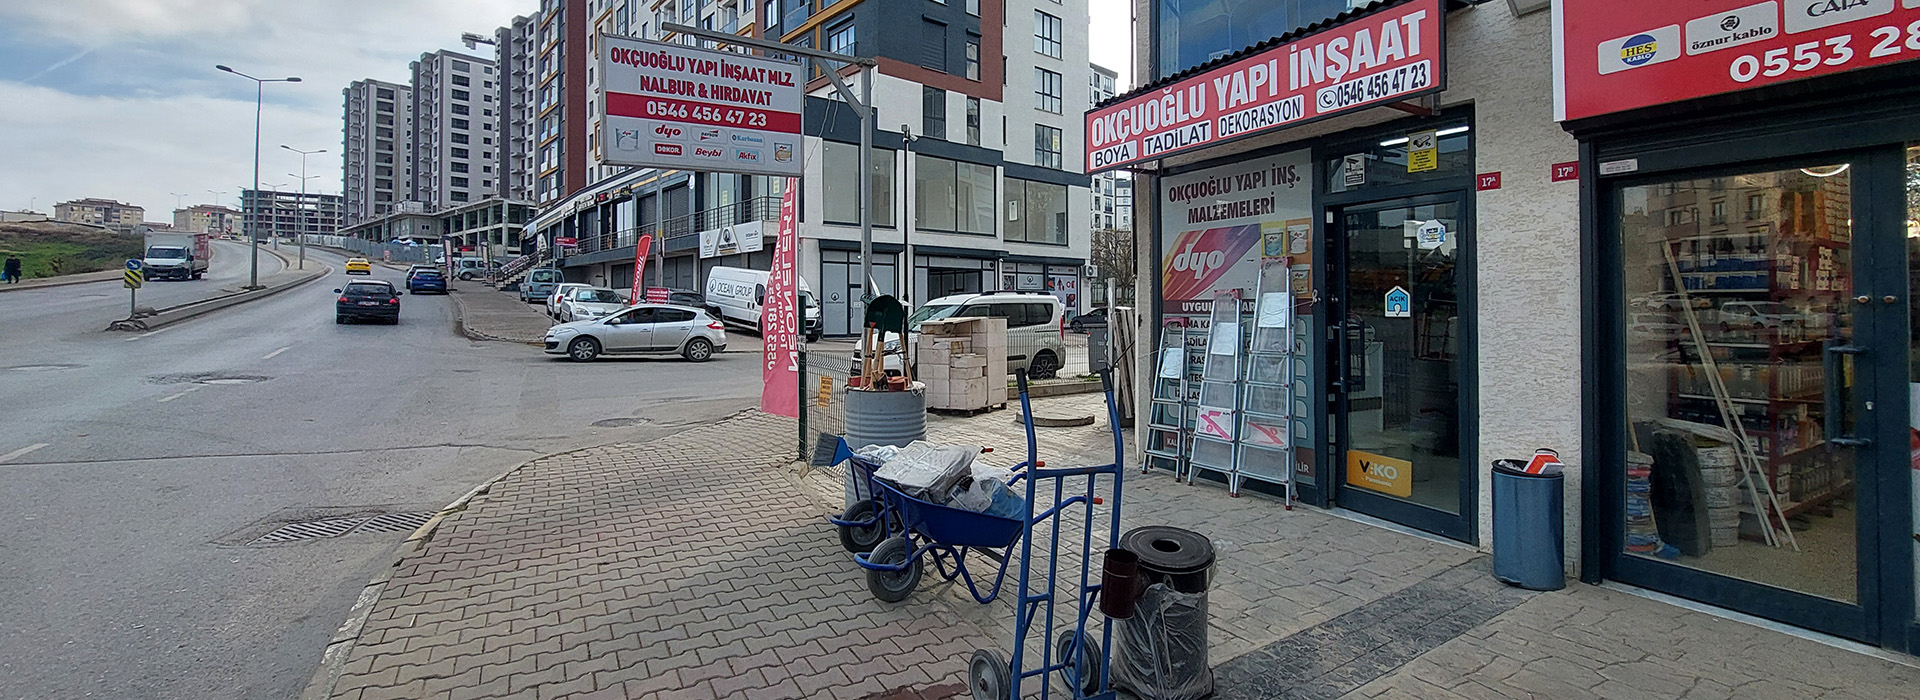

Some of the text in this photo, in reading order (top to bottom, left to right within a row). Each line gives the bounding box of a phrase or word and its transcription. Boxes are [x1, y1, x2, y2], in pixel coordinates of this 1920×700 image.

[1625, 43, 1653, 58] HES
[1692, 26, 1772, 51] öznur kablo
[610, 46, 795, 88] OKÇUOĞLU YAPI İNŞAAT MLZ.
[1626, 53, 1652, 64] KABLO
[1730, 34, 1854, 83] 0553
[640, 75, 772, 107] NALBUR & HIRDAVAT
[1091, 8, 1427, 145] OKÇUOĞLU YAPI İNŞAAT
[1337, 63, 1427, 107] 0546 456 47 23
[646, 100, 767, 127] 0546 456 47 23
[655, 124, 682, 138] dyo
[1094, 145, 1131, 168] BOYA
[1219, 98, 1302, 138] DEKORASYON
[695, 148, 722, 158] Beybi
[1168, 162, 1301, 203] OKÇUOĞLU YAPI İNŞ.
[1187, 191, 1276, 224] MALZEMELERİ
[1173, 243, 1225, 280] dyo
[717, 282, 753, 299] OCEAN GROUP
